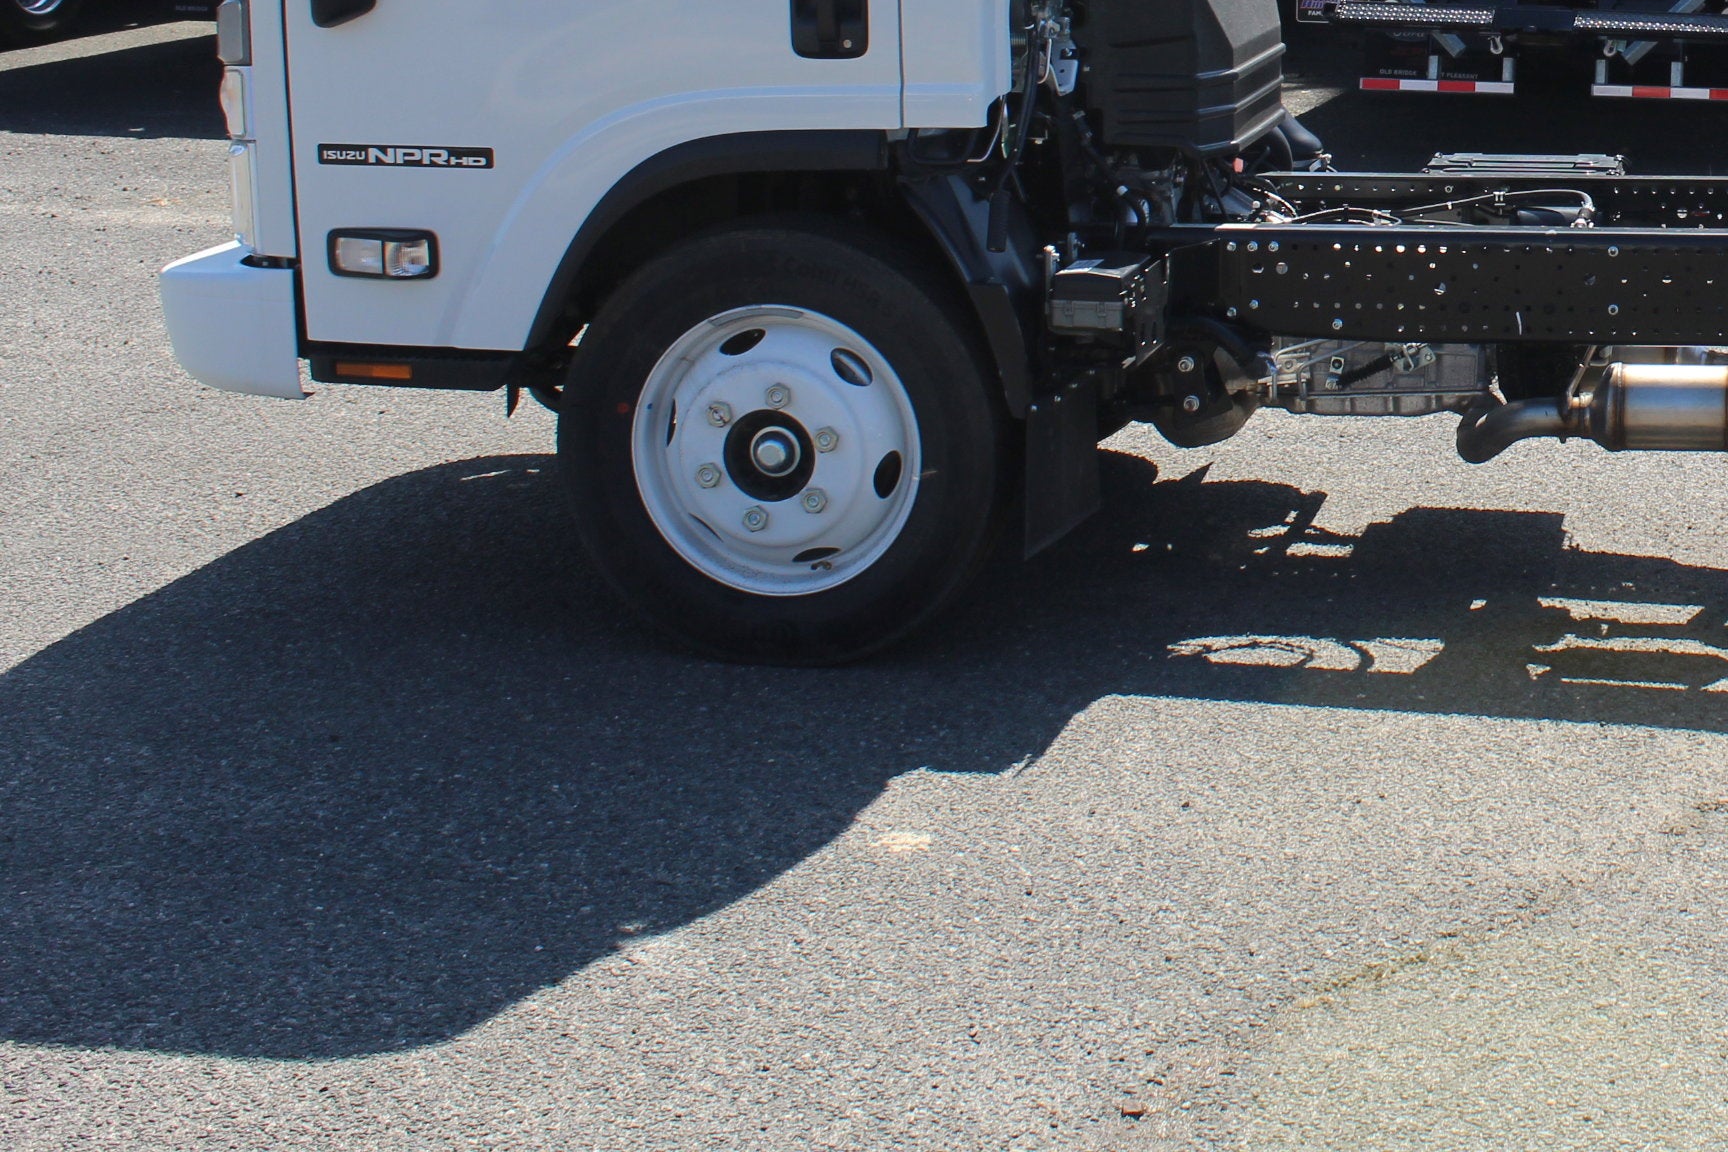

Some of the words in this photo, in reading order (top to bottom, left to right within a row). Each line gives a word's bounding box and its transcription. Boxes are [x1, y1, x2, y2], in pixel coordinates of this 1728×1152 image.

[322, 149, 366, 160] ISUZU
[367, 147, 449, 166] NPR
[449, 156, 487, 166] HD
